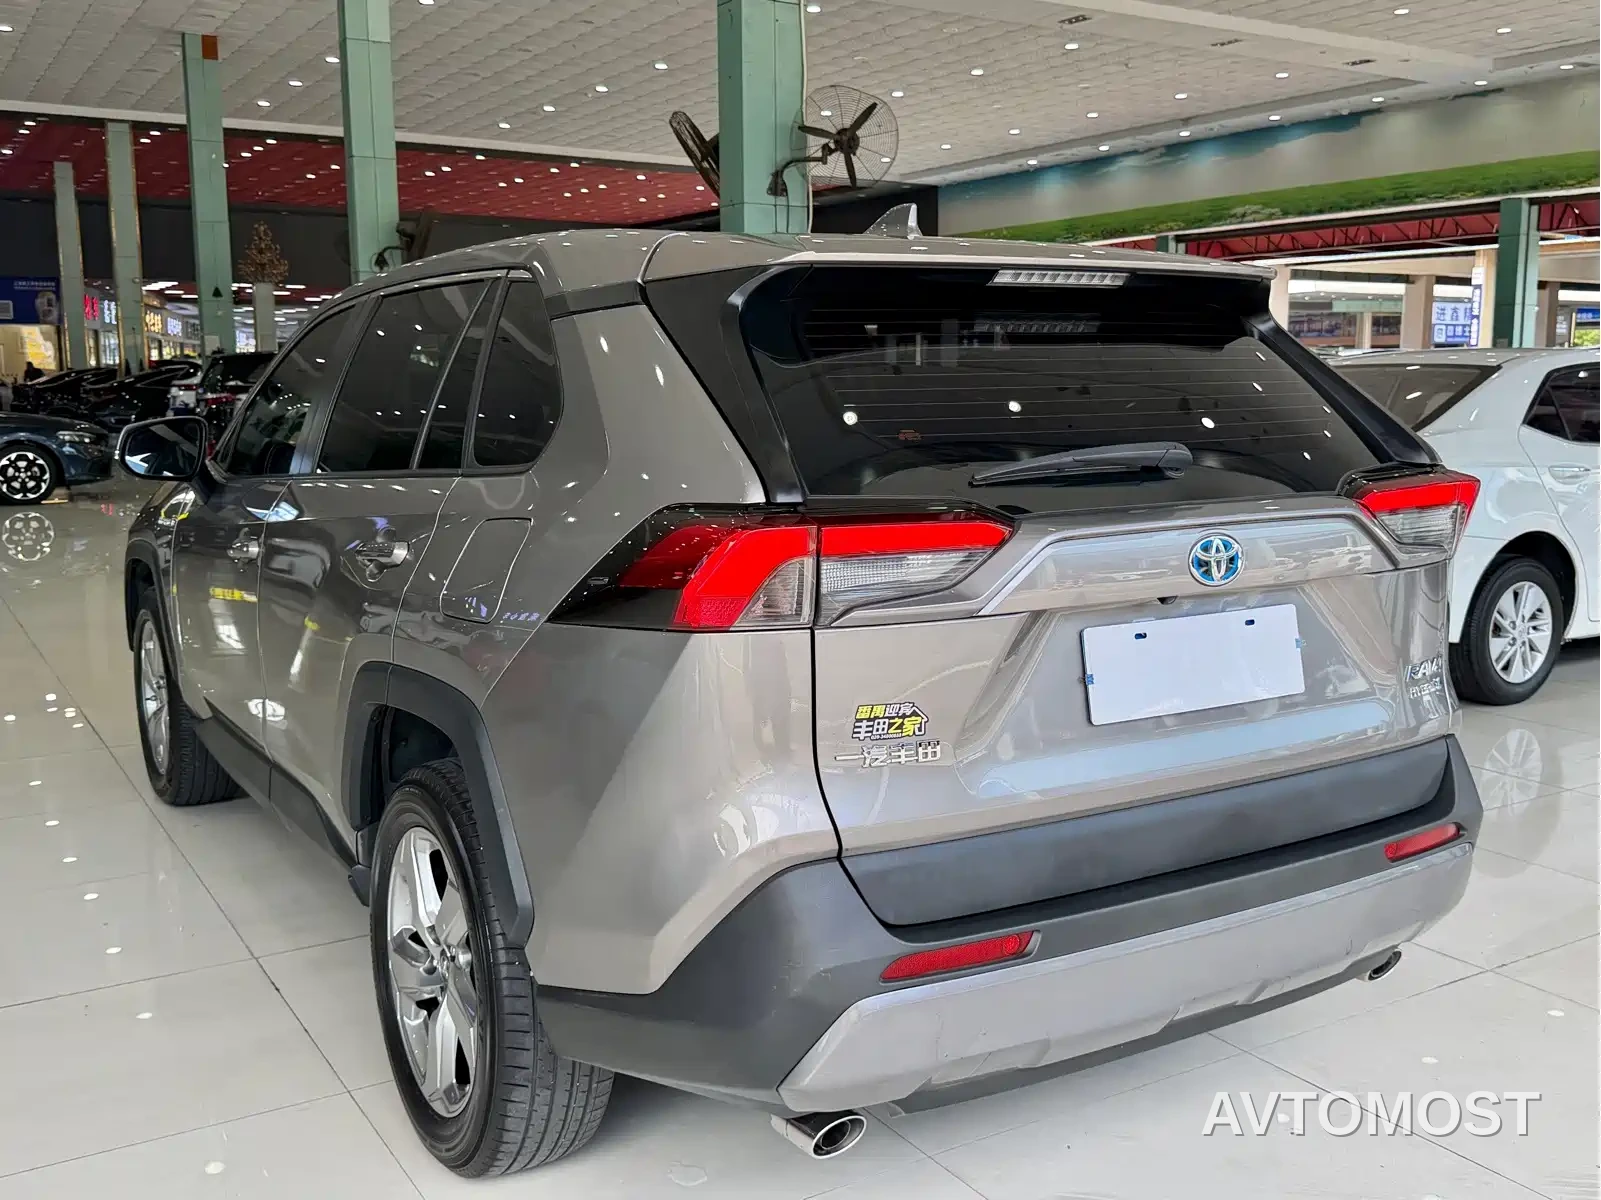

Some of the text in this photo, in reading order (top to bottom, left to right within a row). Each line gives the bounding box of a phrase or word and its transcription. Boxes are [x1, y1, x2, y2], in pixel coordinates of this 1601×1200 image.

[852, 716, 922, 740] 丰田之家
[834, 741, 940, 767] 一汽丰田
